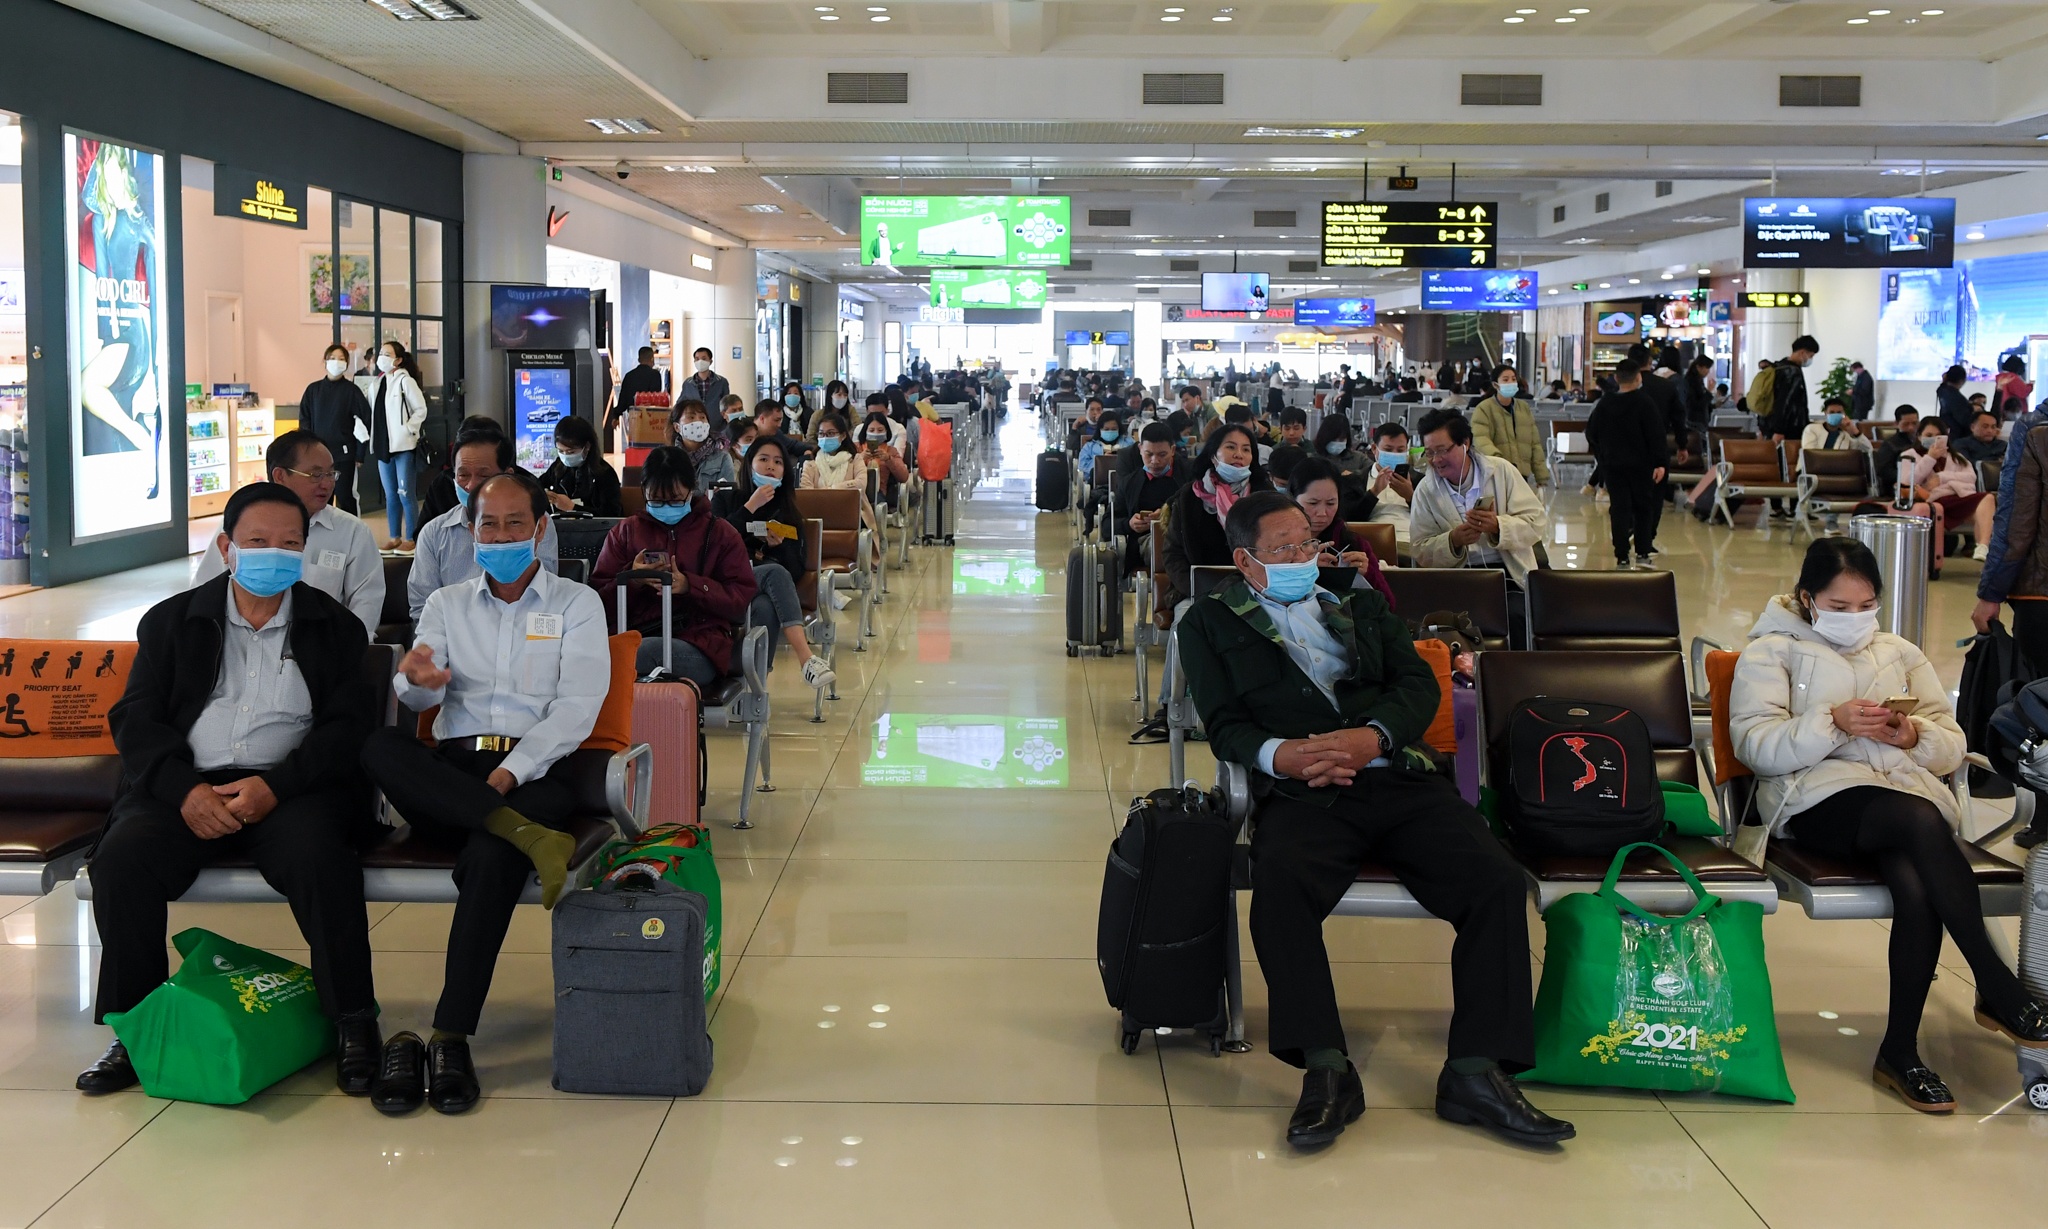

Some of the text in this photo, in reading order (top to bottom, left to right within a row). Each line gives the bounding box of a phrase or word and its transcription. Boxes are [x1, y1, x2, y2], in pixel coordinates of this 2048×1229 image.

[256, 180, 284, 205] Shine
[1326, 214, 1358, 222] Boarding
[1326, 235, 1358, 243] Boarding
[1758, 230, 1830, 241] Đặc Quyền Vô Hạn
[1362, 257, 1401, 266] Playground
[120, 279, 150, 304] GIRL
[921, 305, 964, 323] Flight
[1266, 308, 1294, 318] FASTF
[1094, 332, 1101, 341] 7
[245, 973, 291, 992] 2021
[1626, 995, 1644, 1003] LONG
[1646, 996, 1670, 1006] THÀNH
[1636, 1003, 1678, 1013] RESIDENTIAL
[1632, 1022, 1697, 1050] 2021
